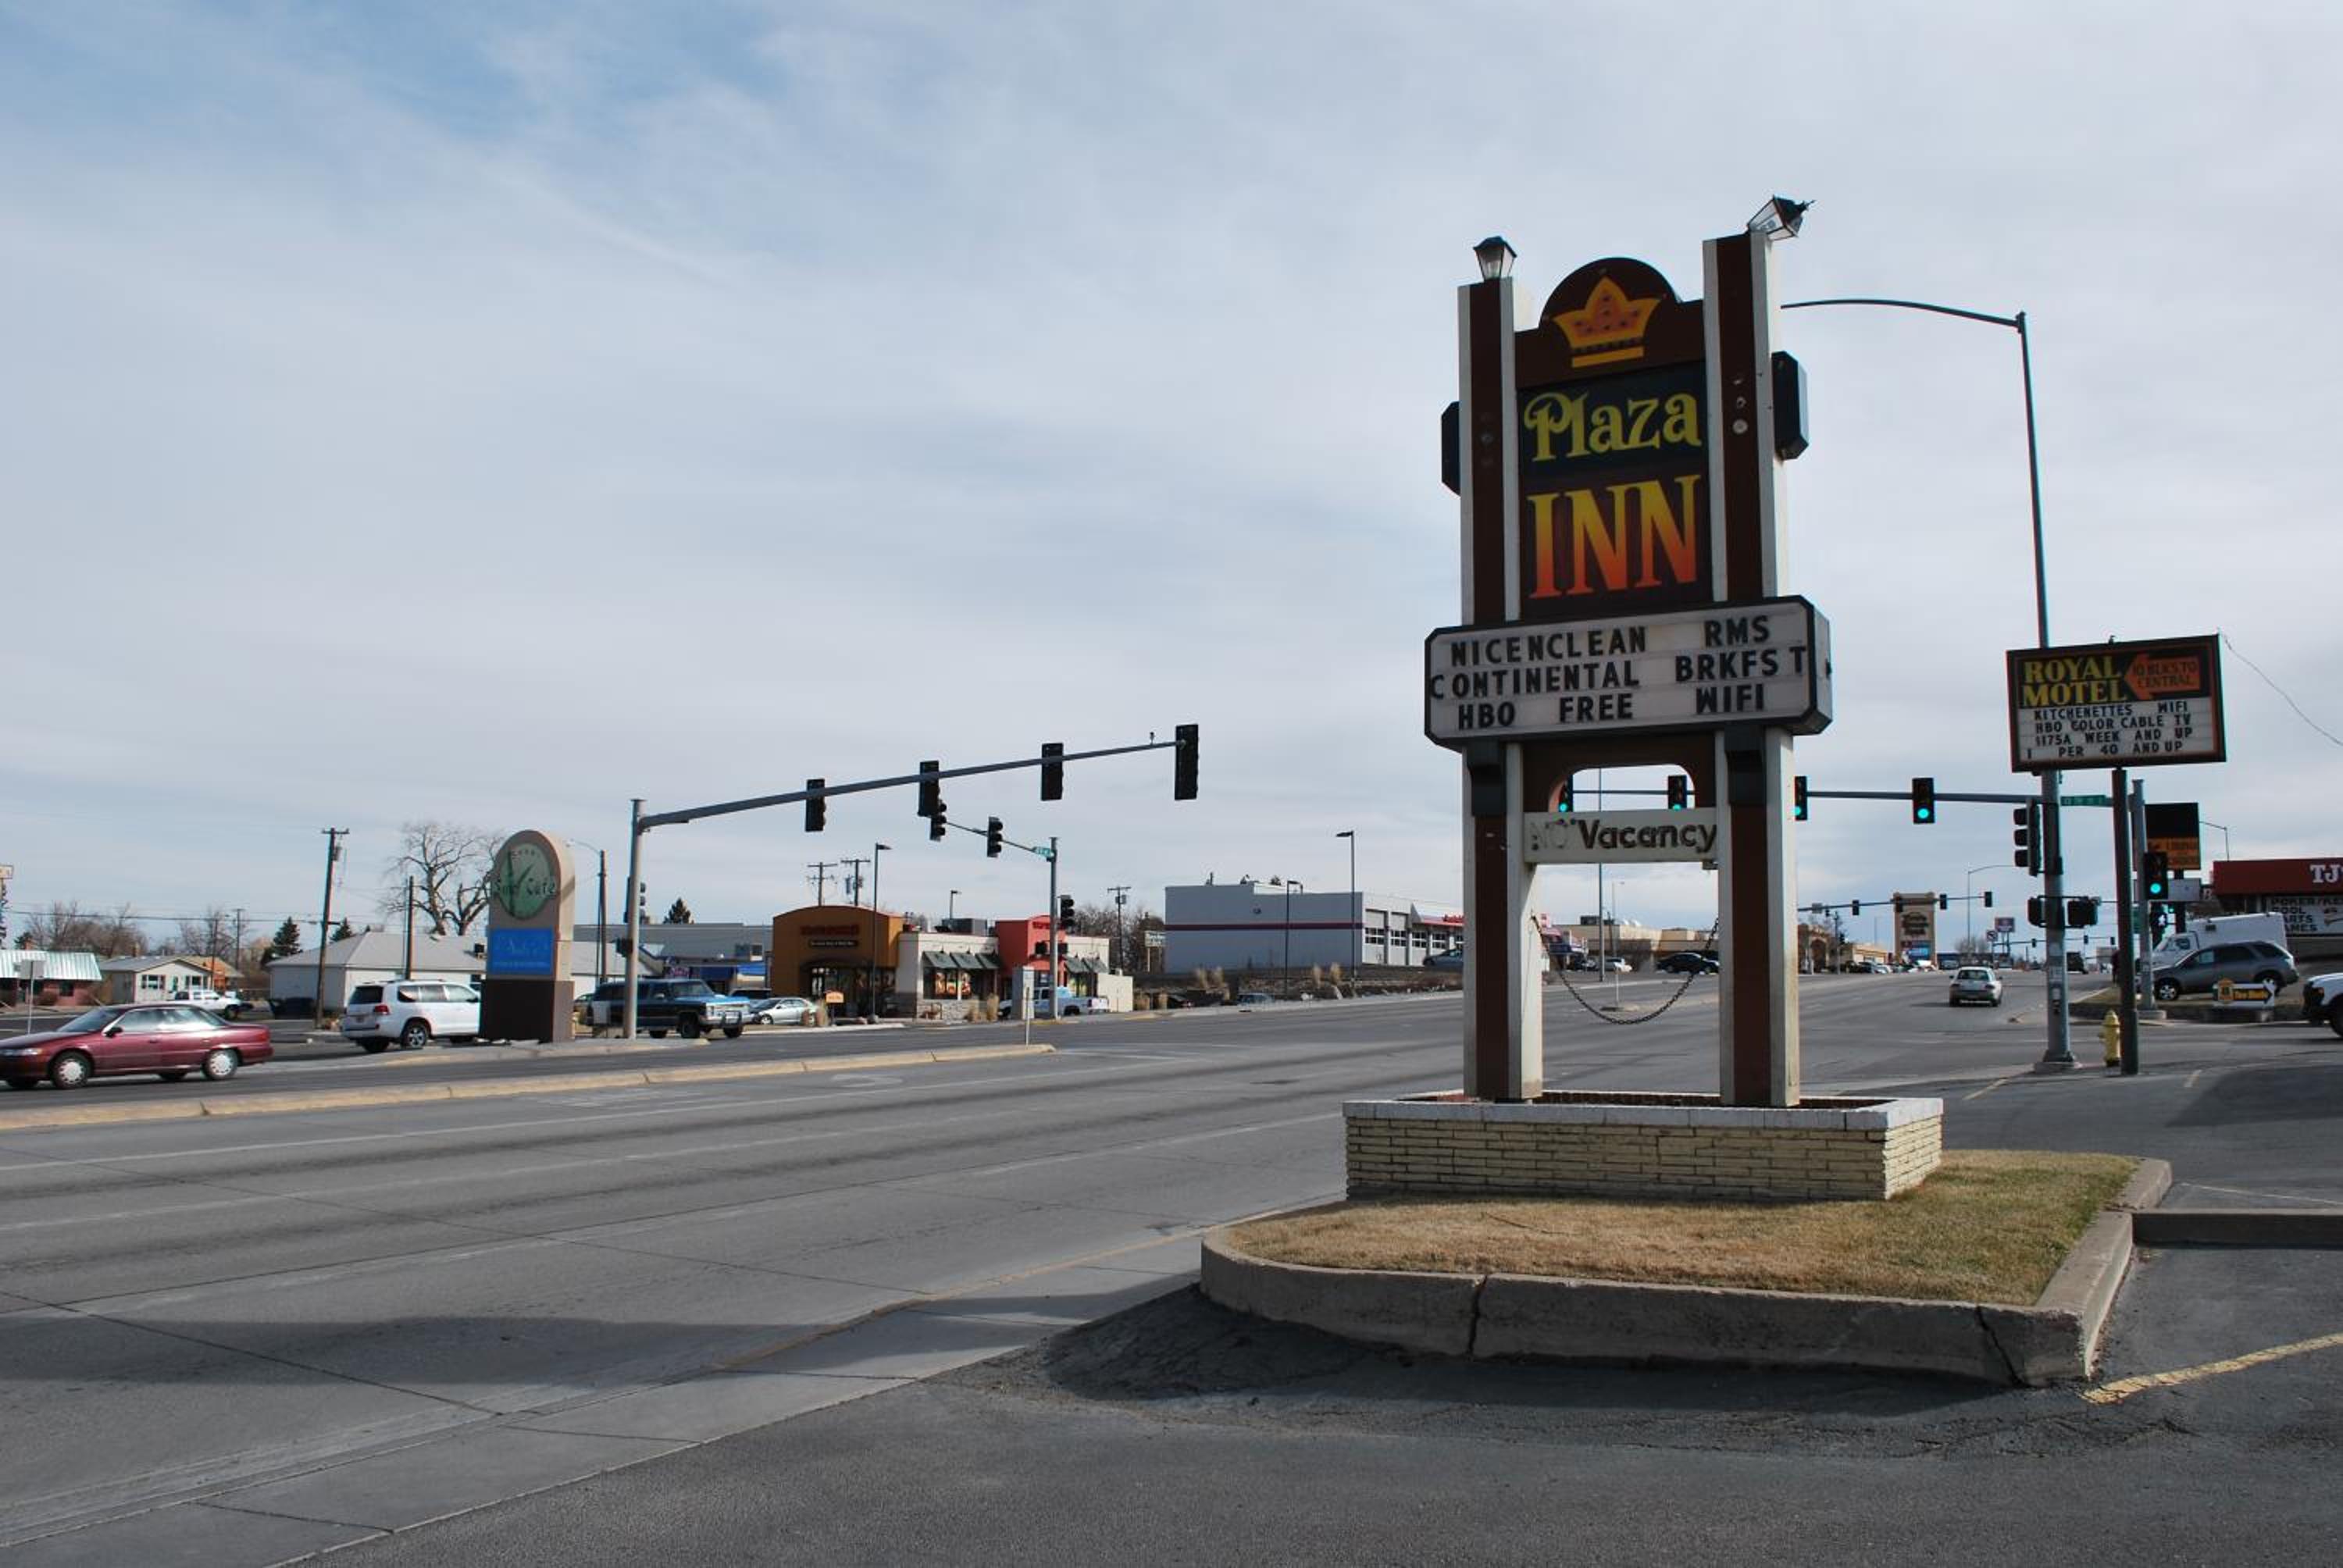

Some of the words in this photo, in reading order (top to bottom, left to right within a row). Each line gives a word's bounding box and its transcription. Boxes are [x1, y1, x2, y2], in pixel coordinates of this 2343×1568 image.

[1524, 392, 1702, 461] Plaza
[1526, 474, 1701, 598] INN
[1451, 625, 1646, 667] NICENCLEAN
[1706, 615, 1770, 648] RMS
[1431, 661, 1639, 700] CONTINENTAL
[2024, 656, 2121, 682] ROYAL
[1458, 702, 1515, 730] HBO
[1560, 693, 1633, 723] FREE
[1696, 683, 1765, 715] WIFI
[2024, 679, 2127, 707] MOTEL
[2035, 704, 2133, 720] KITCHENETTES
[2158, 700, 2188, 713] WIFI
[2036, 722, 2063, 734] HBO
[2071, 718, 2113, 732] COLOR
[2121, 715, 2164, 729] CABLE
[2174, 713, 2191, 725] TV
[2059, 746, 2084, 757] PER
[2101, 743, 2119, 755] 40
[2133, 741, 2159, 754] AND
[2164, 740, 2183, 752] UP
[2085, 731, 2120, 743] WEEK
[2135, 729, 2162, 740] AND
[2174, 727, 2193, 739] UP
[1578, 818, 1717, 853] Vacancy
